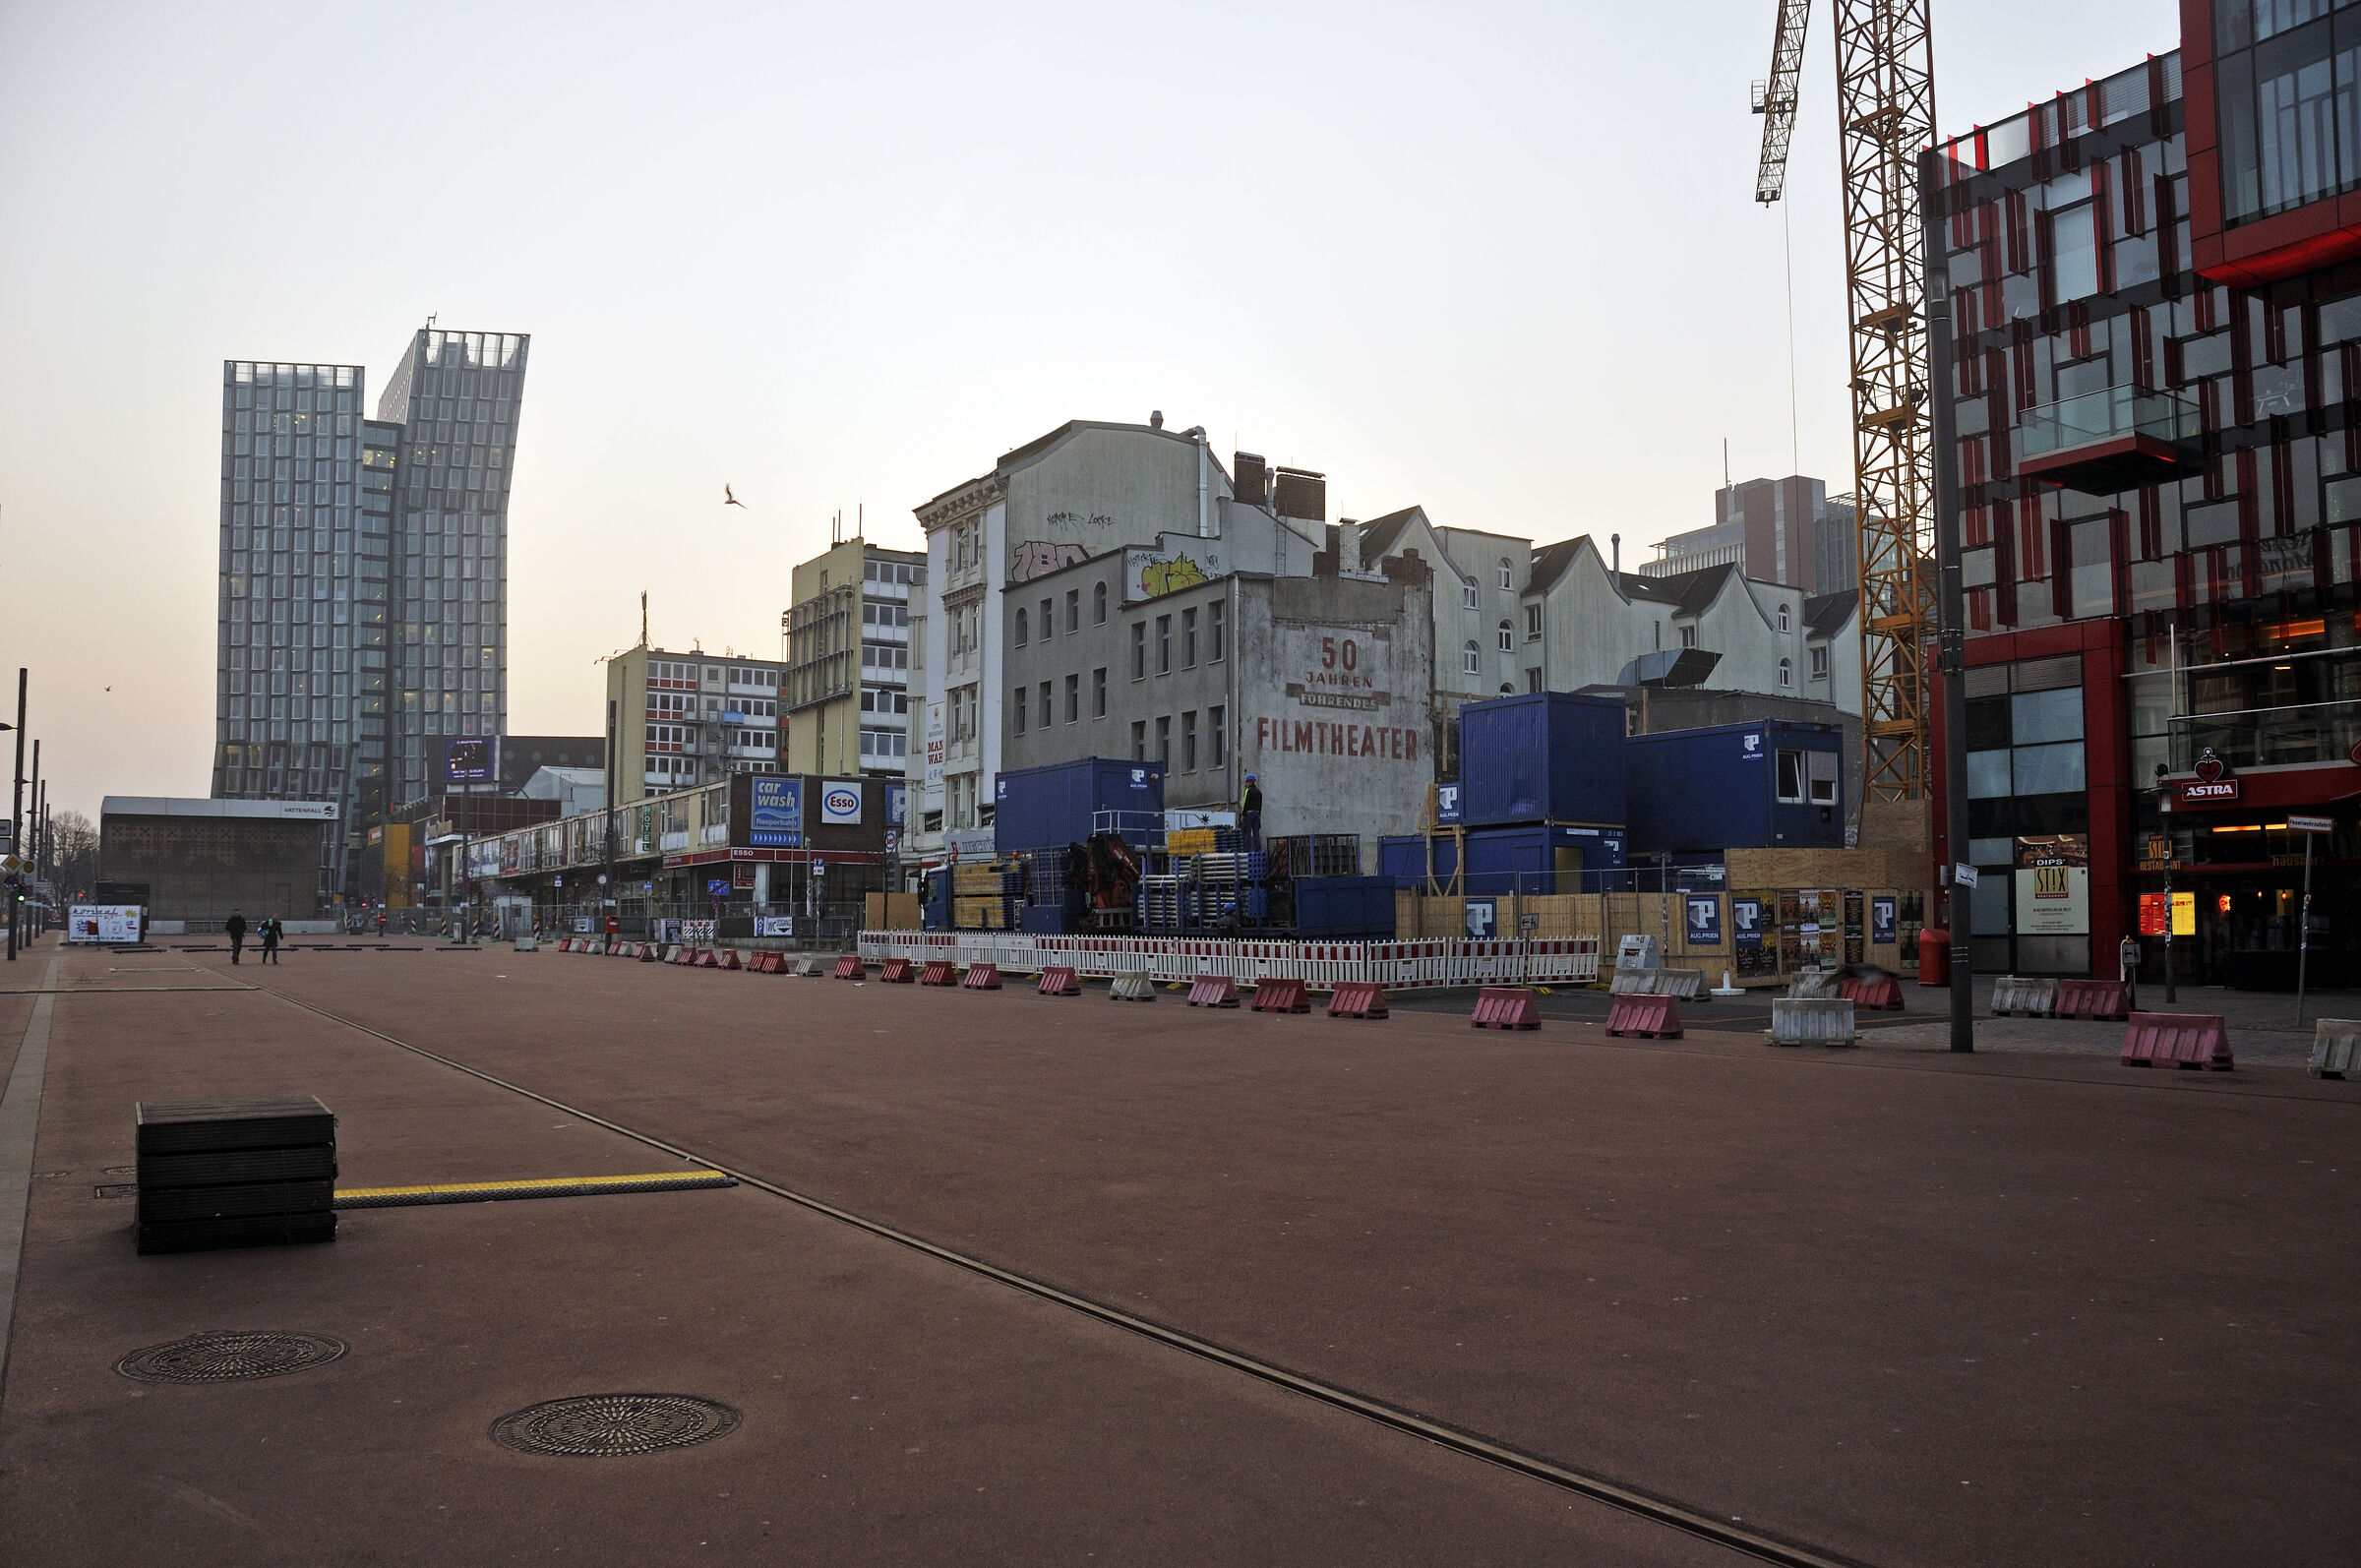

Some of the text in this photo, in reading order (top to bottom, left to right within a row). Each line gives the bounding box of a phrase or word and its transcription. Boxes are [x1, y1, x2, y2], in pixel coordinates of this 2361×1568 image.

[1321, 636, 1357, 671] 50
[1305, 671, 1372, 689] JAHREN
[1301, 693, 1377, 709] FÜHRENDES
[1256, 716, 1418, 760] FILMTHEATER
[757, 781, 781, 794] car
[2186, 784, 2234, 797] ASTRA
[757, 791, 796, 808] wash
[830, 796, 854, 809] Esso
[641, 804, 652, 852] HOTEL
[756, 817, 798, 827] Reeperbahn
[767, 921, 777, 932] WC
